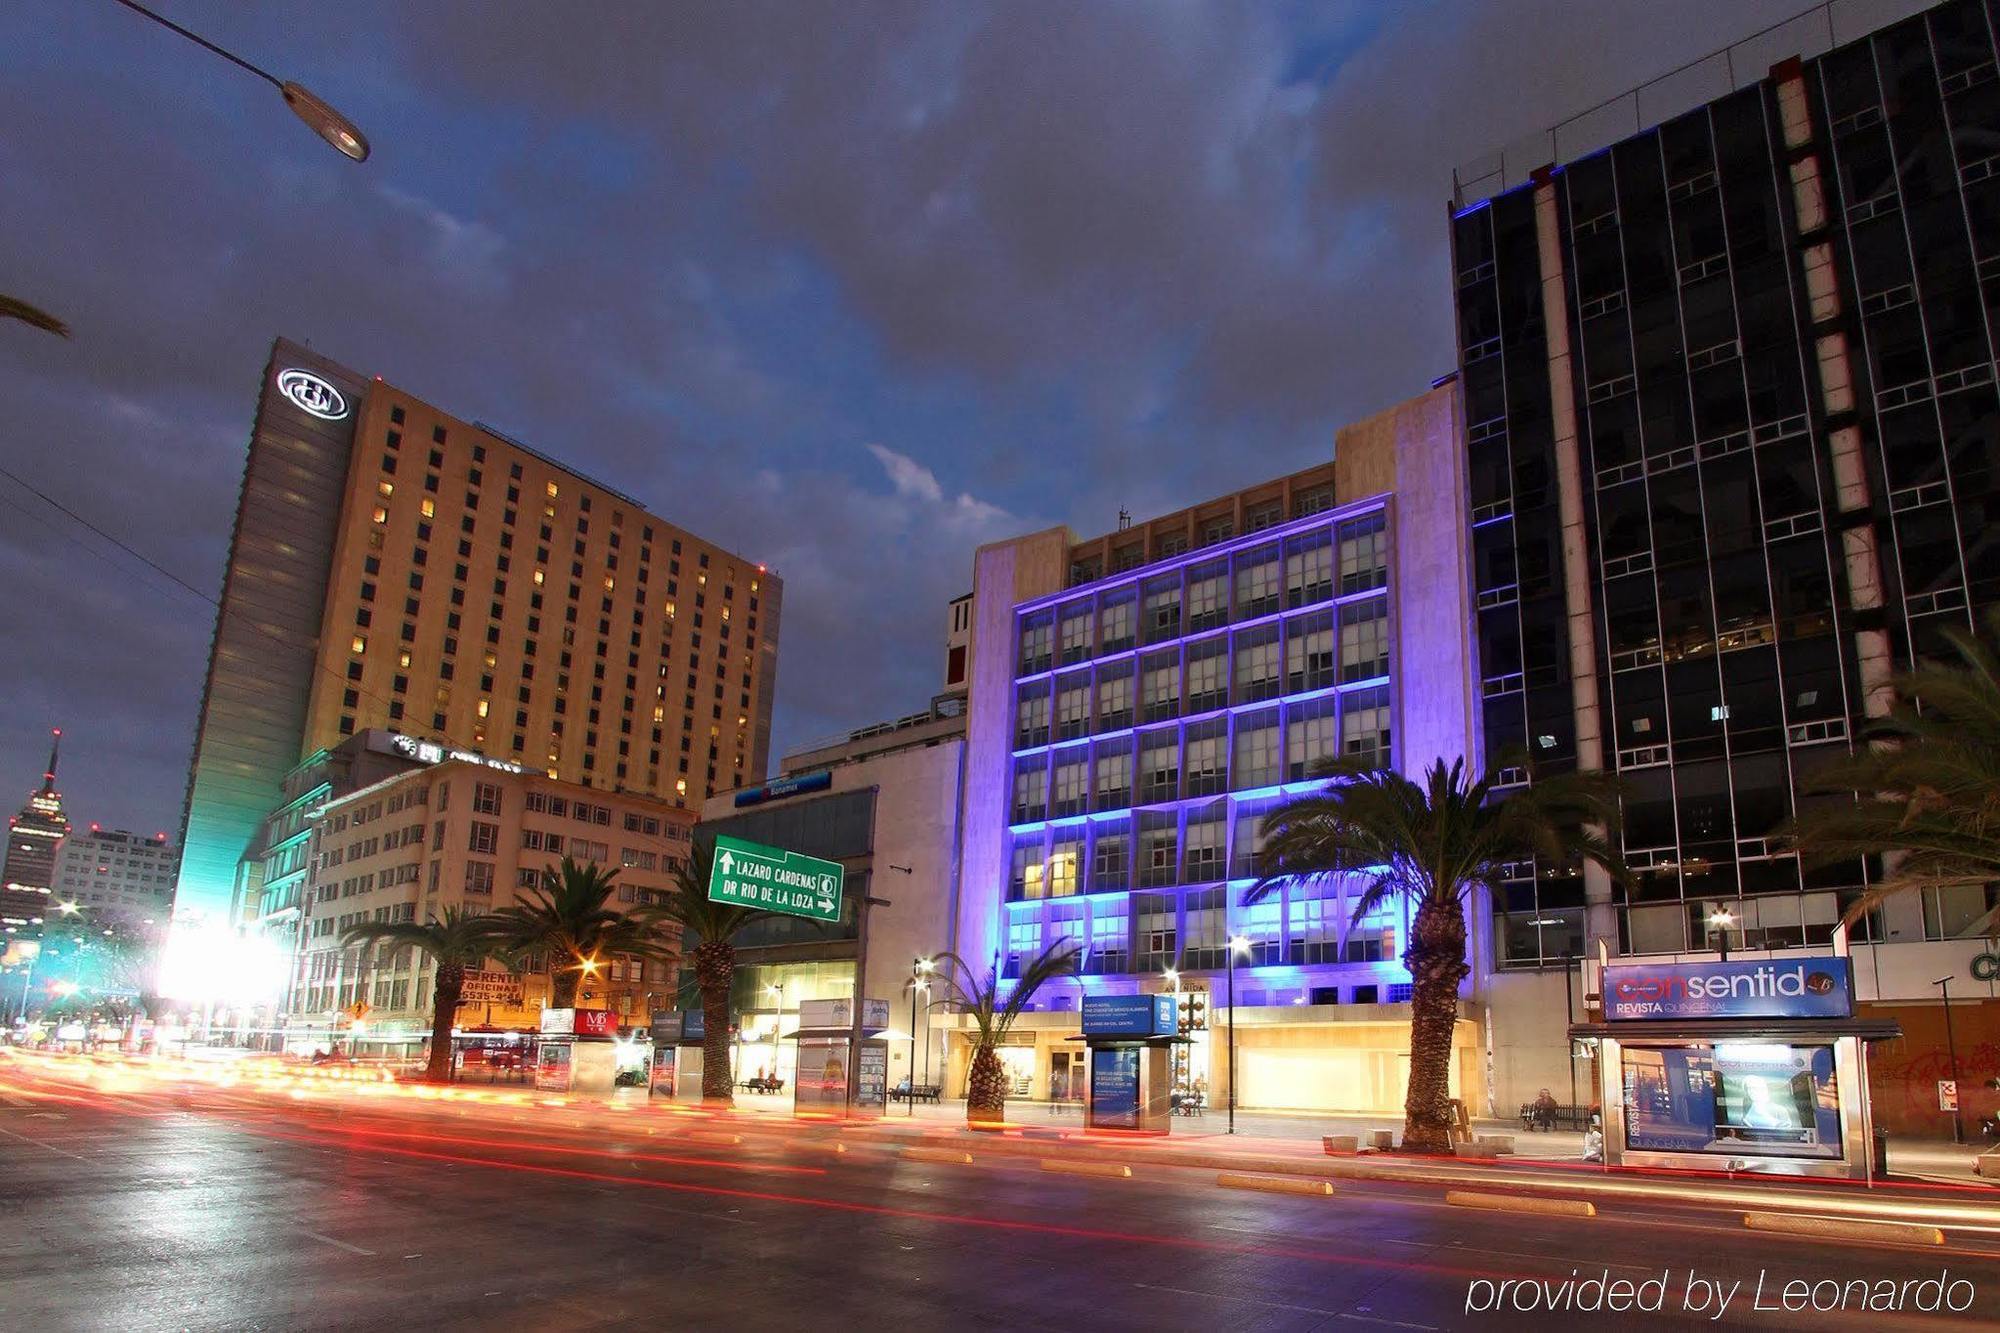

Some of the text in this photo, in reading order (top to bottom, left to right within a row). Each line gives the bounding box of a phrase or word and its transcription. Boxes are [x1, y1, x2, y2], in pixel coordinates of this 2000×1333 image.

[736, 860, 817, 890] LAZARO CARDENAS
[722, 879, 814, 910] DR RIO DE LA LOZA
[466, 982, 519, 993] OFICINAS
[1165, 985, 1204, 993] AVNIDA
[1616, 1002, 1663, 1014] REVISTA
